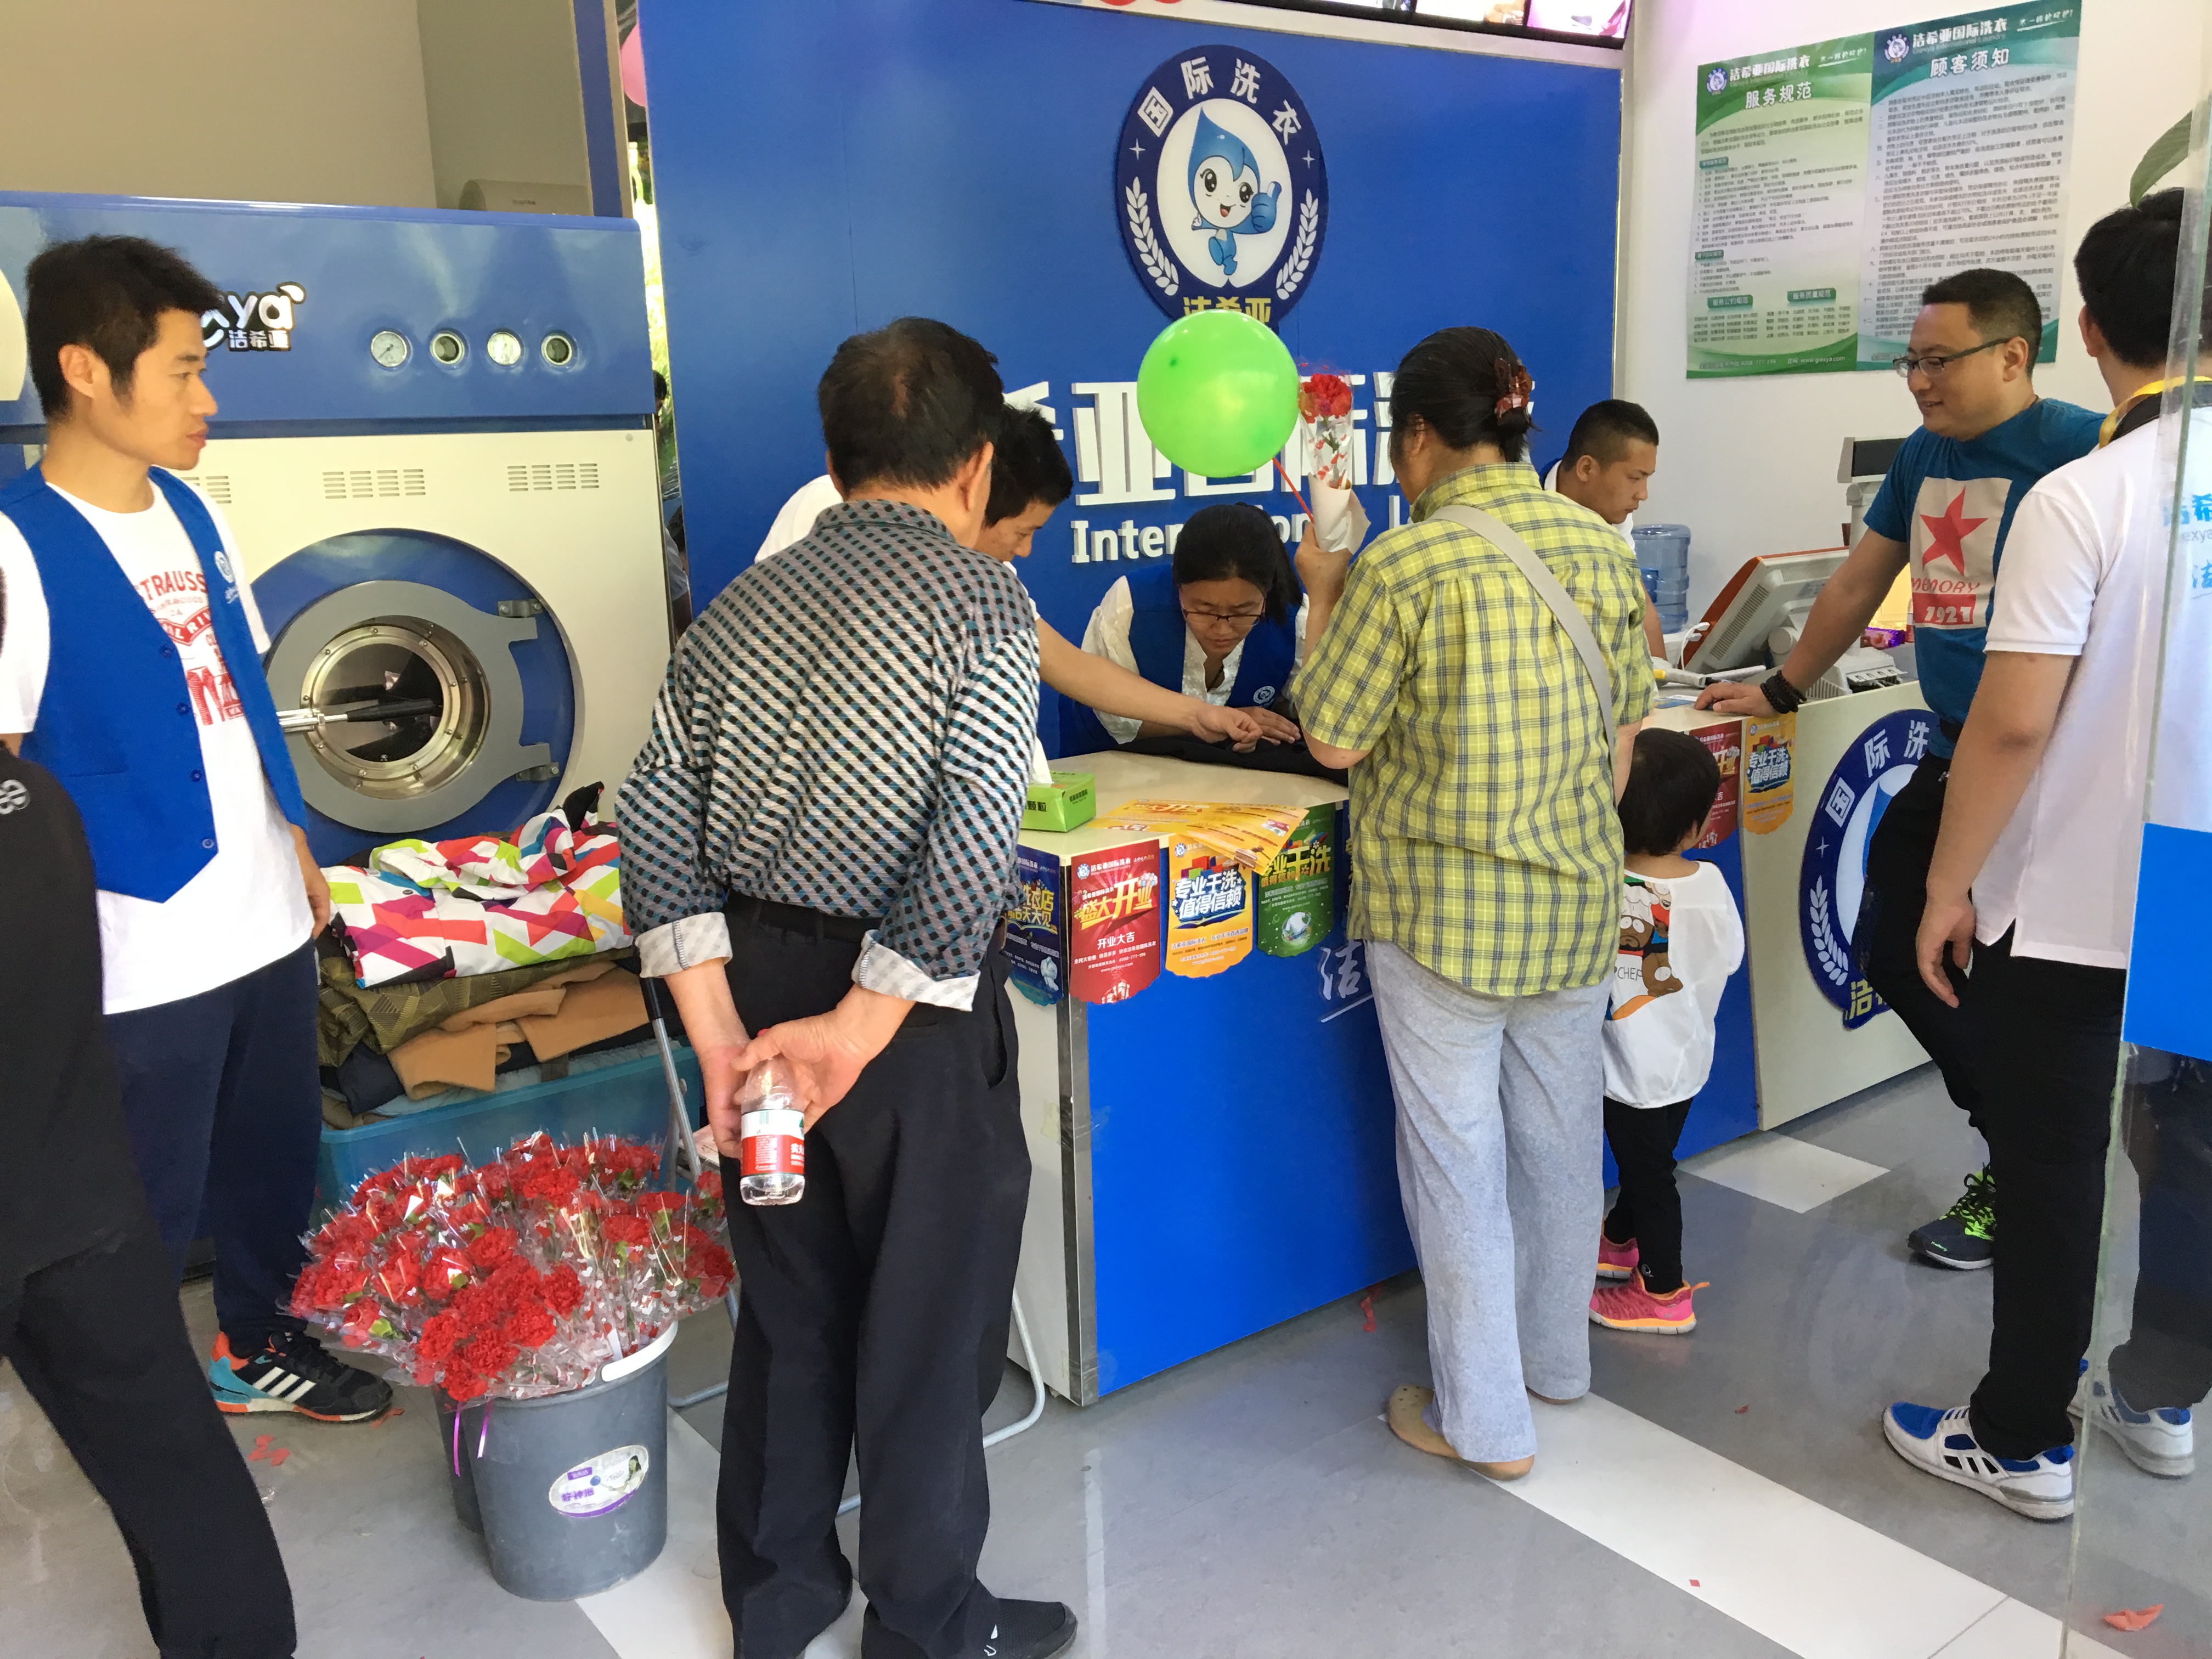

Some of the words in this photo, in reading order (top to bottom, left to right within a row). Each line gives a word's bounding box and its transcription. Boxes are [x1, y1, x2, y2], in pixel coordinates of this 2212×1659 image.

[1913, 18, 2007, 48] 洁希亚国际洗衣
[1730, 55, 1810, 82] 洁希亚国际洗衣
[1929, 48, 2010, 78] 顾客须知
[1137, 56, 1301, 145] 国际洗衣
[1745, 81, 1812, 109] 服务规范
[228, 329, 290, 349] 洁希亚
[135, 571, 207, 600] TRAUSS
[1748, 746, 1787, 768] 专业干洗
[1751, 761, 1788, 785] 值得信赖
[1175, 868, 1237, 899] 专业干洗
[1080, 877, 1154, 921] 盛大开业
[1180, 887, 1242, 919] 值得信赖
[1097, 932, 1135, 950] 开业大吉
